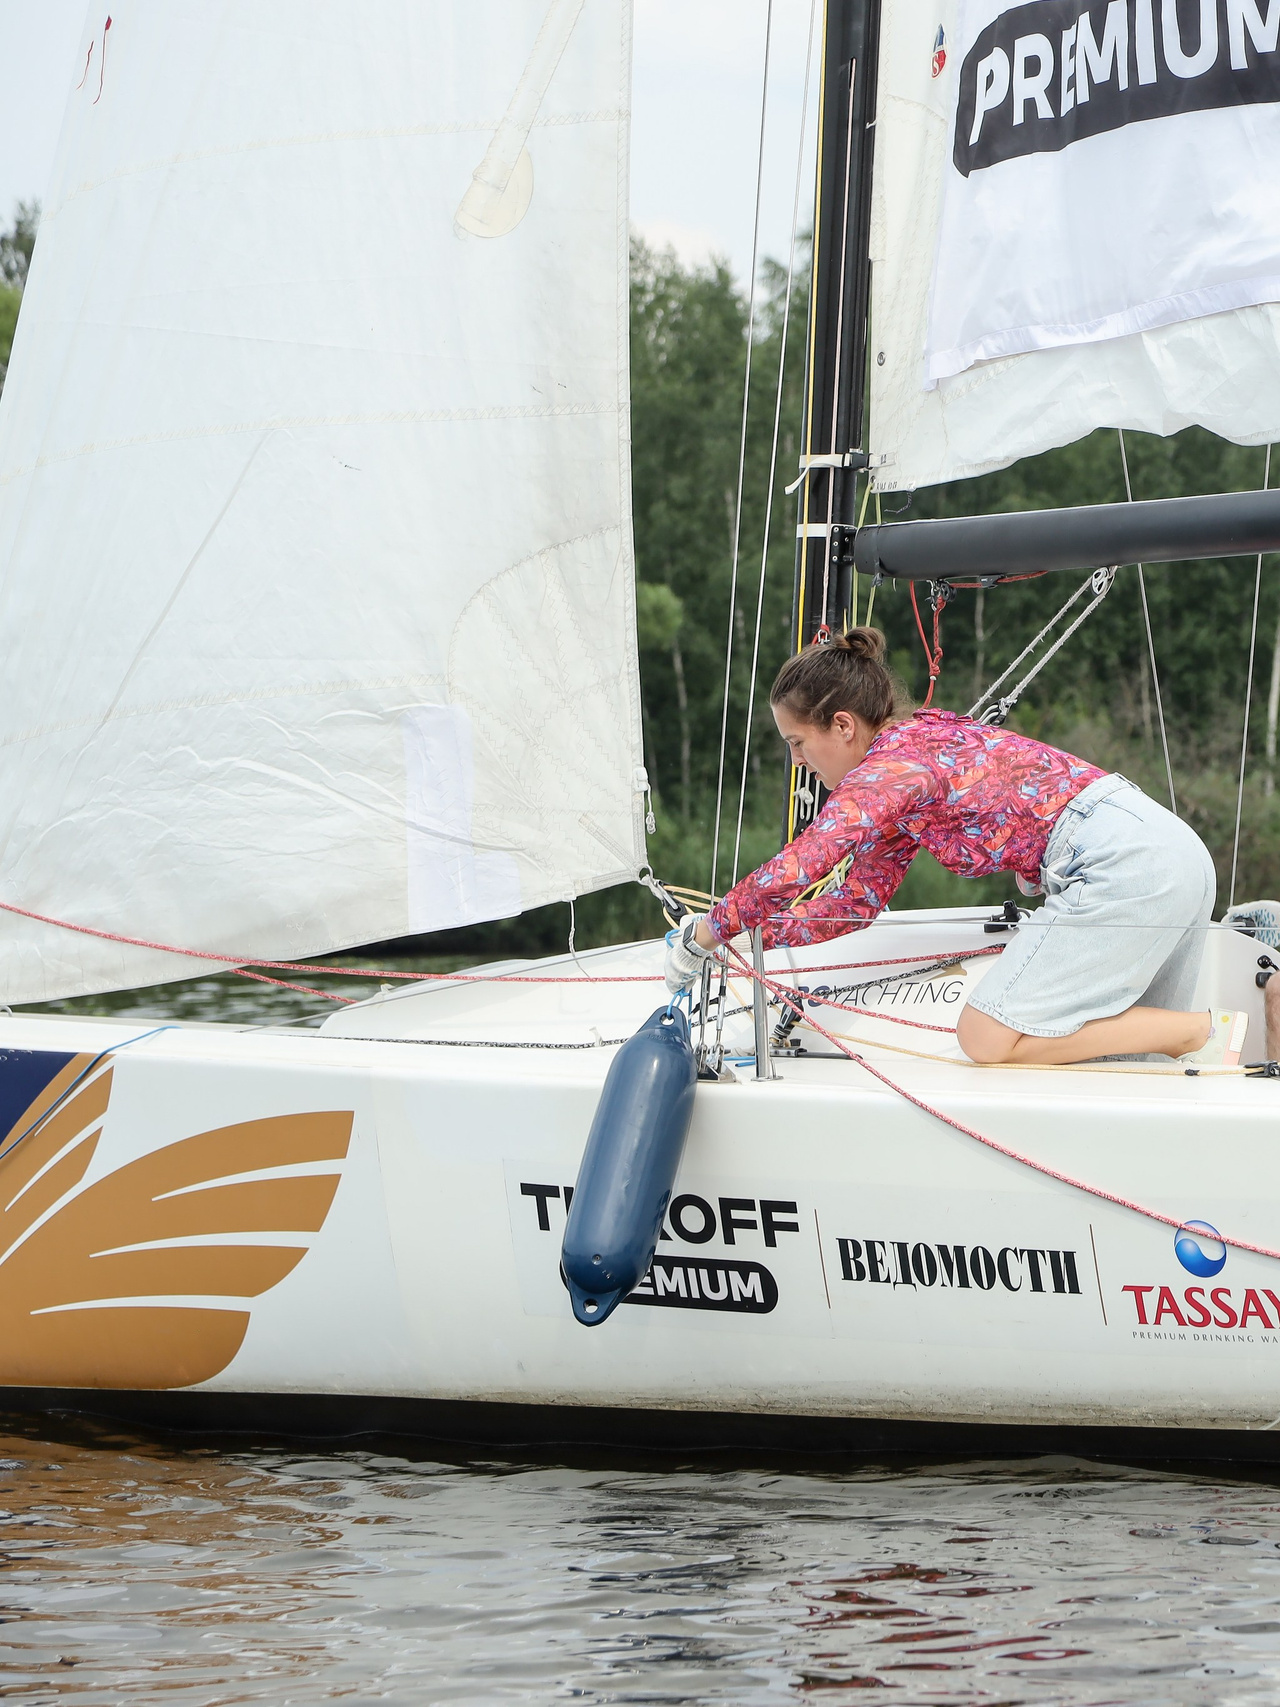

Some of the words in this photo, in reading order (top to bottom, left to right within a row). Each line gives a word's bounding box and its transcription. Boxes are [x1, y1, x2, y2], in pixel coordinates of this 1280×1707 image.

[520, 1183, 800, 1248] TOFF
[836, 1238, 1083, 1295] ВЕДОМОСТИ
[1132, 1331, 1187, 1341] PREMIUM
[1193, 1333, 1255, 1343] DRINKING
